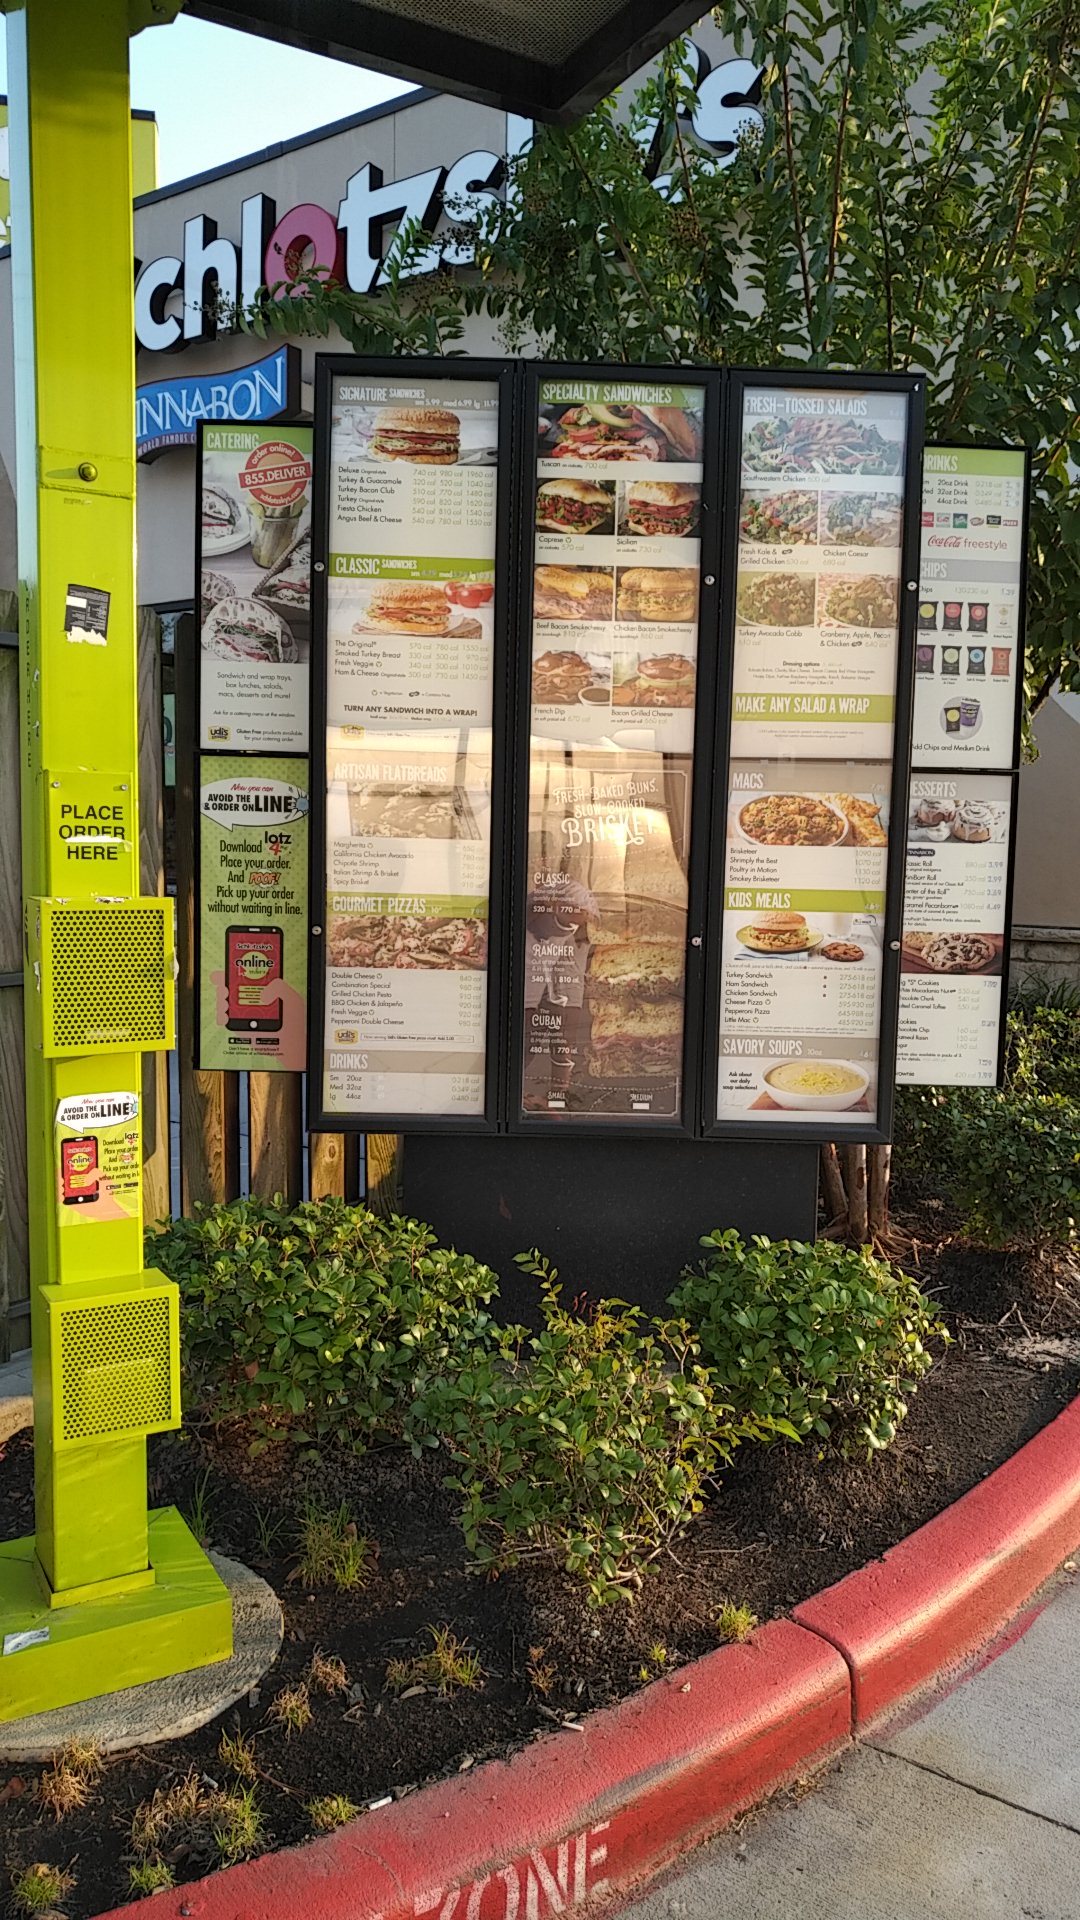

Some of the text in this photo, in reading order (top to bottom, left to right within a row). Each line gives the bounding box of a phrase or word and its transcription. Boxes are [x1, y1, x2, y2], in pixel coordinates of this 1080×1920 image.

[136, 356, 283, 438] INNABON
[339, 387, 425, 401] SIGNATURE SANDWICHES
[543, 383, 672, 403] SPECIALTY SANDWICHES
[745, 397, 867, 415] FRESH-TOSSED SALADS
[138, 439, 159, 456] WORLD
[163, 434, 188, 445] FAMOUS
[207, 433, 259, 449] CATERING
[252, 444, 295, 464] order online!
[245, 466, 306, 485] 855.DELIVER
[339, 466, 359, 474] Deluxe
[338, 485, 395, 494] Turkey Bacon Club
[338, 495, 357, 503] Turkey
[338, 504, 381, 513] Fiesta Chicken
[964, 538, 1007, 551] freestyle
[335, 557, 417, 575] CLASSIC SANDWICHES
[739, 630, 757, 638] Turkey
[361, 650, 380, 659] Turkey
[383, 651, 401, 659] Breast
[353, 660, 374, 669] Veggie
[344, 705, 363, 713] TURN
[366, 705, 381, 713] ANY
[384, 706, 423, 715] SANDWICH
[453, 709, 478, 717] WRAP!
[735, 696, 870, 714] MAKE ANY SALAD A WRAP
[924, 744, 939, 752] Chips
[334, 764, 447, 783] ARTISAN FLATBREADS
[733, 773, 764, 789] MACS
[552, 778, 658, 805] FRESH-BAKED BUNS.
[910, 781, 957, 797] ESSERTS
[208, 794, 233, 802] AVOID
[212, 803, 239, 811] ORDER
[255, 795, 292, 812] LINE
[61, 805, 123, 820] PLACE
[574, 798, 645, 818] SLOW-COOKED
[59, 825, 125, 840] ORDER
[265, 831, 292, 844] lotz
[67, 846, 118, 860] HERE
[220, 840, 262, 853] Download
[221, 855, 291, 870] Place your order.
[228, 871, 281, 885] And POOF!
[217, 886, 294, 901] Pick up your order
[728, 892, 791, 909] KIDS MEALS
[208, 901, 302, 916] without waiting in line.
[333, 896, 426, 913] GOURMET PIZZAS
[532, 944, 574, 957] RANCHER
[236, 955, 274, 968] online
[532, 1015, 562, 1030] CUBAN
[723, 1039, 802, 1055] SAVORY SOUPS
[330, 1053, 368, 1069] DRINKS
[547, 1091, 566, 1099] SMALL
[629, 1093, 653, 1101] MEDIUM
[64, 1105, 97, 1114] AVOID THE
[101, 1103, 130, 1117] LINE
[103, 1138, 124, 1146] Download
[68, 1155, 92, 1164] online
